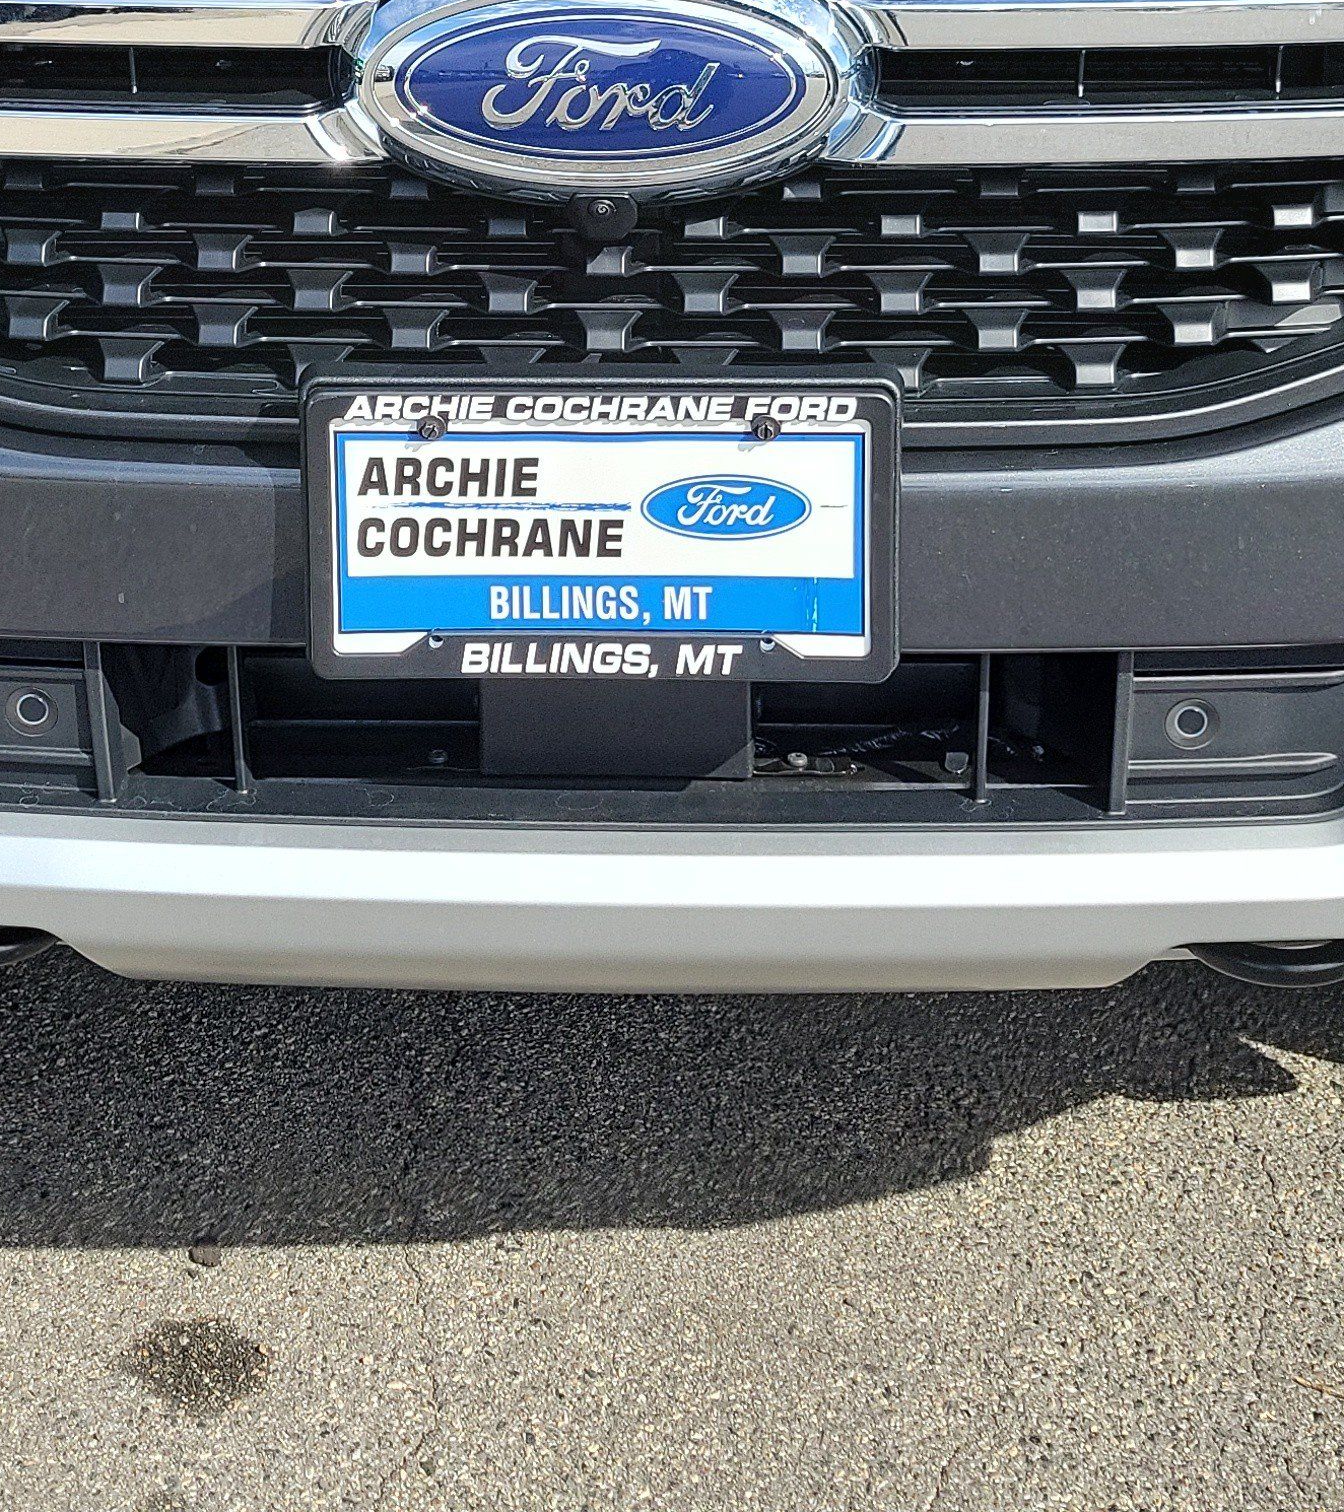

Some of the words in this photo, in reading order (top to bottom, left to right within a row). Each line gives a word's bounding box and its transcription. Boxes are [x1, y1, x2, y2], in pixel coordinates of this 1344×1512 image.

[482, 34, 720, 131] Ford
[344, 395, 498, 421] ARCHIE
[506, 395, 734, 421] COCHRANE
[744, 395, 858, 422] FORD
[357, 457, 539, 498] ARCHIE
[676, 484, 774, 527] Ford
[356, 518, 624, 558] COCHRANE
[489, 586, 651, 624] BILLINGS,
[664, 586, 712, 619] MT
[460, 642, 659, 678] BILLINGS,
[675, 645, 743, 675] MT
